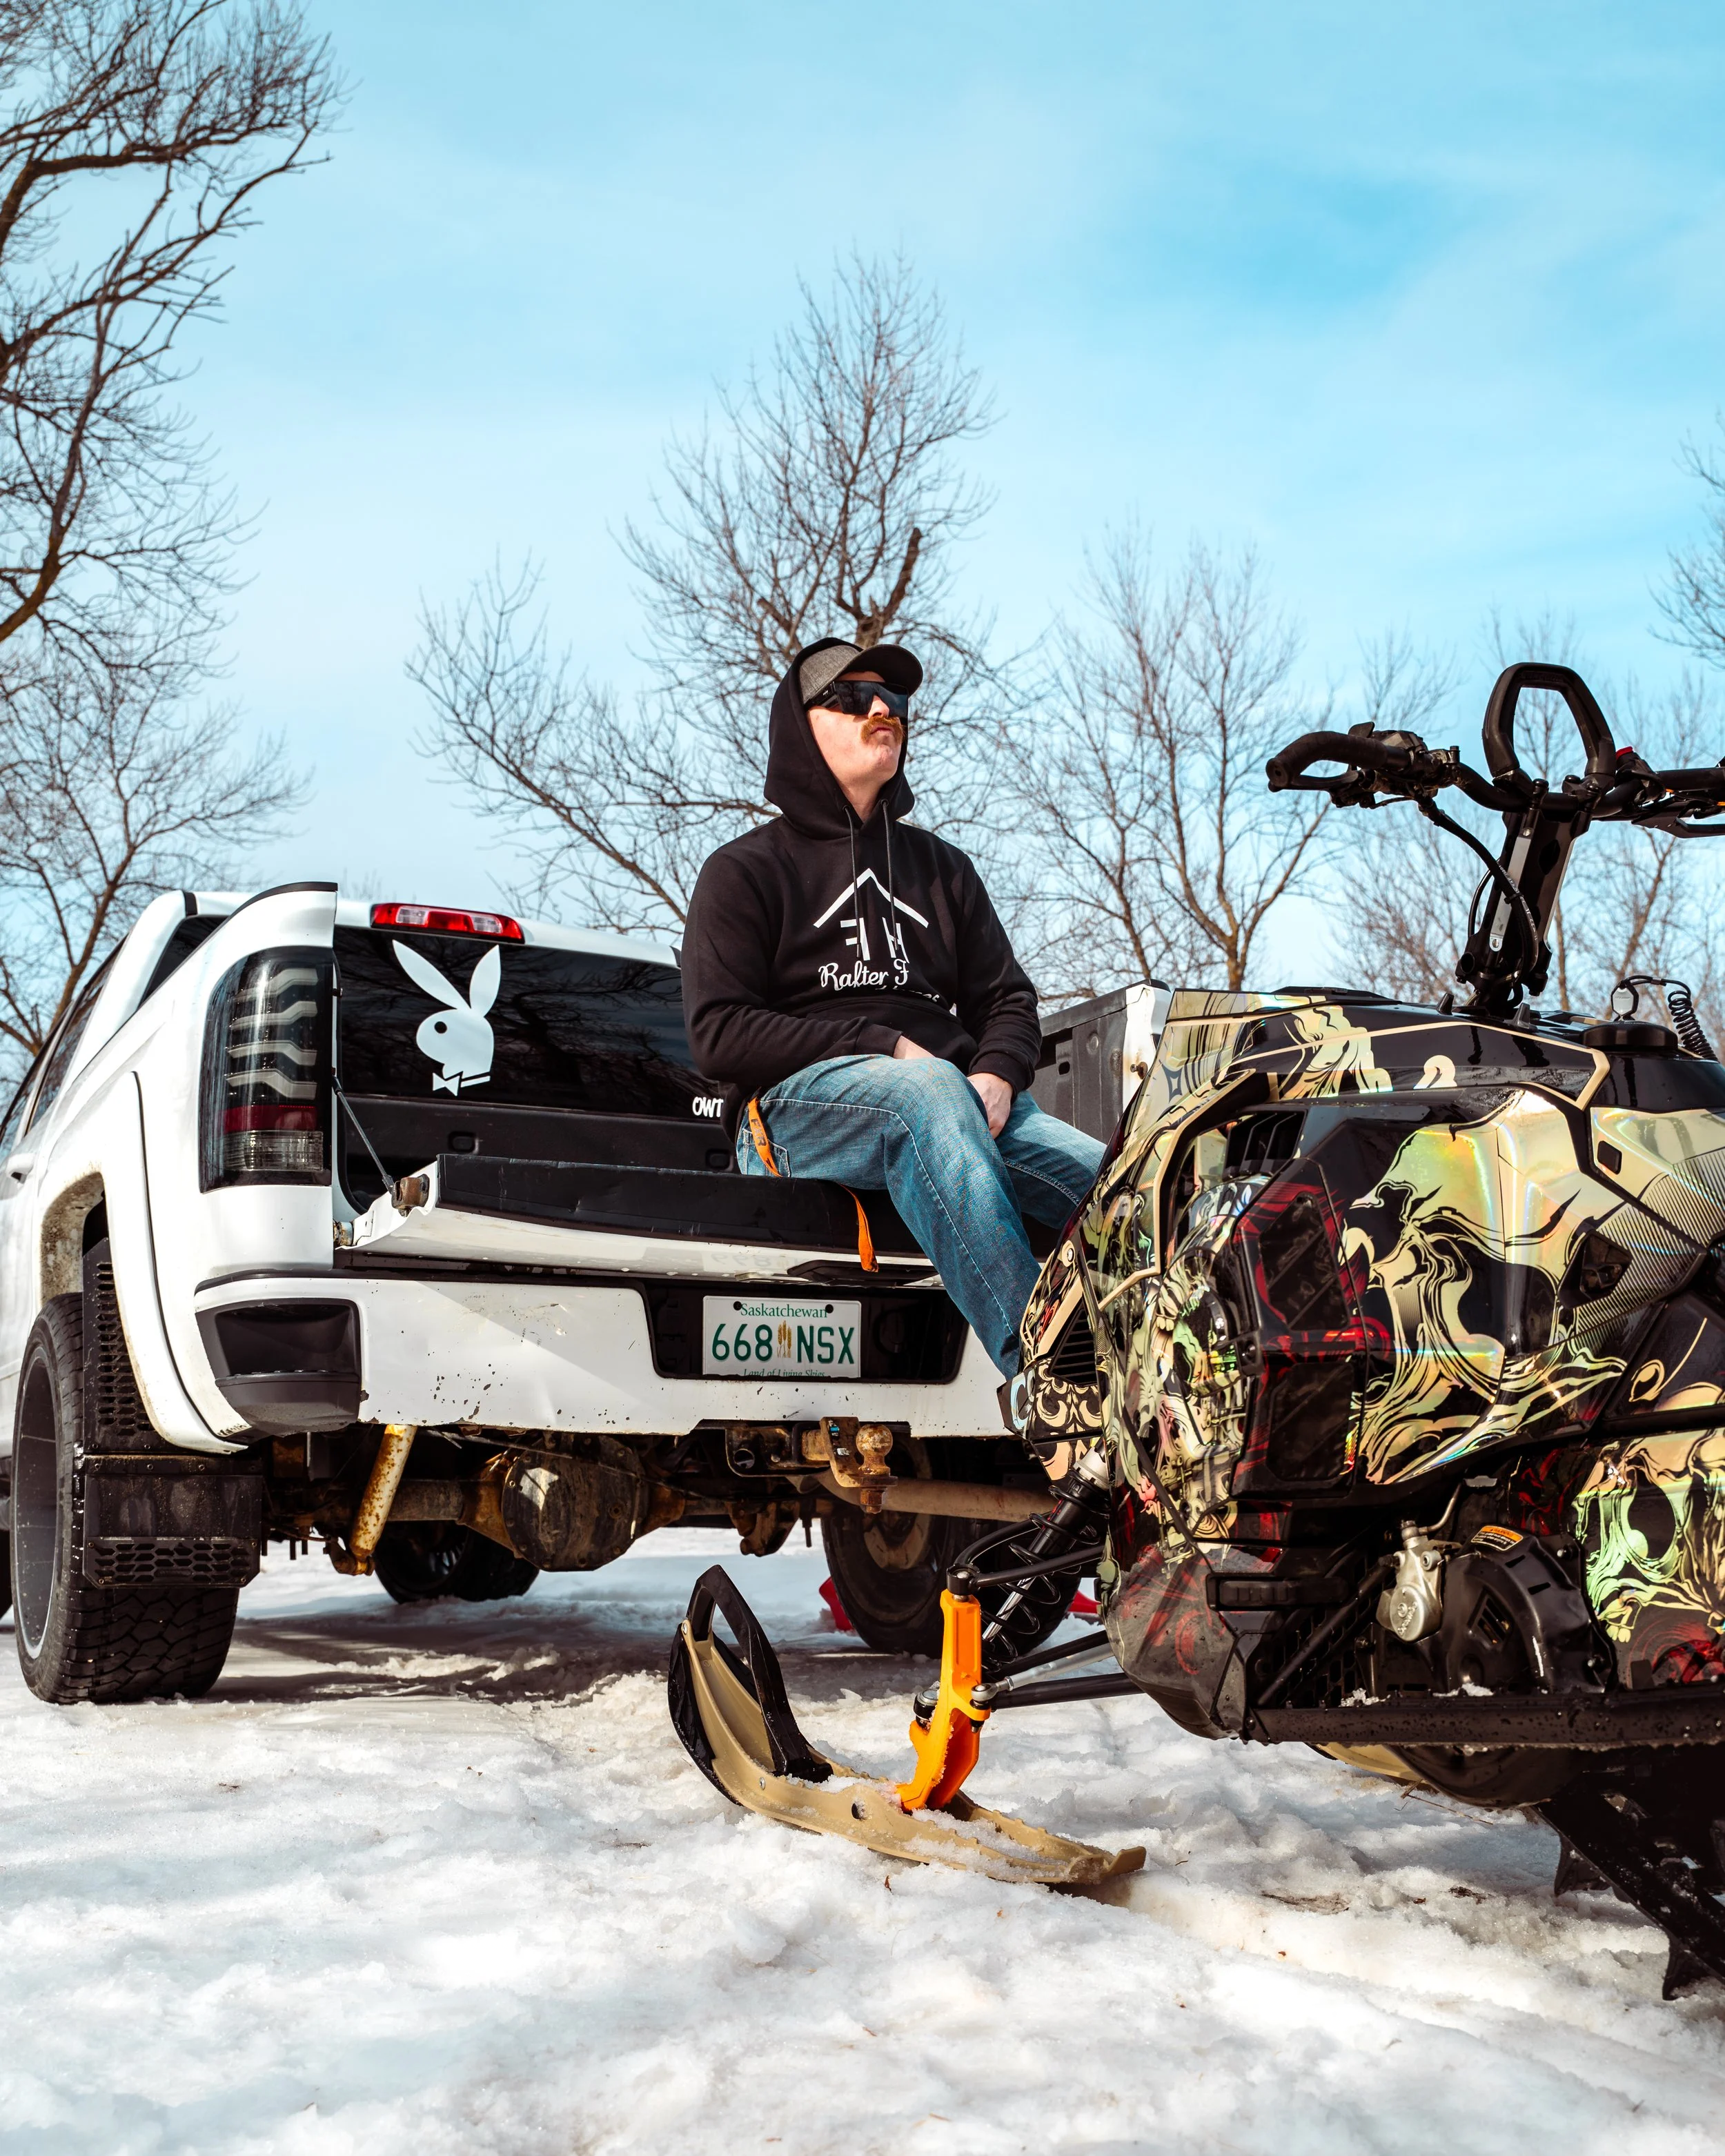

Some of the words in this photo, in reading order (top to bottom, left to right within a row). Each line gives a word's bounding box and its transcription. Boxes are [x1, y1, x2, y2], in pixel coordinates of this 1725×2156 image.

[818, 960, 889, 991] Rafter
[893, 958, 909, 985] F
[740, 1303, 828, 1318] Saskatchewan
[711, 1323, 773, 1362] 668
[796, 1325, 855, 1364] NSX
